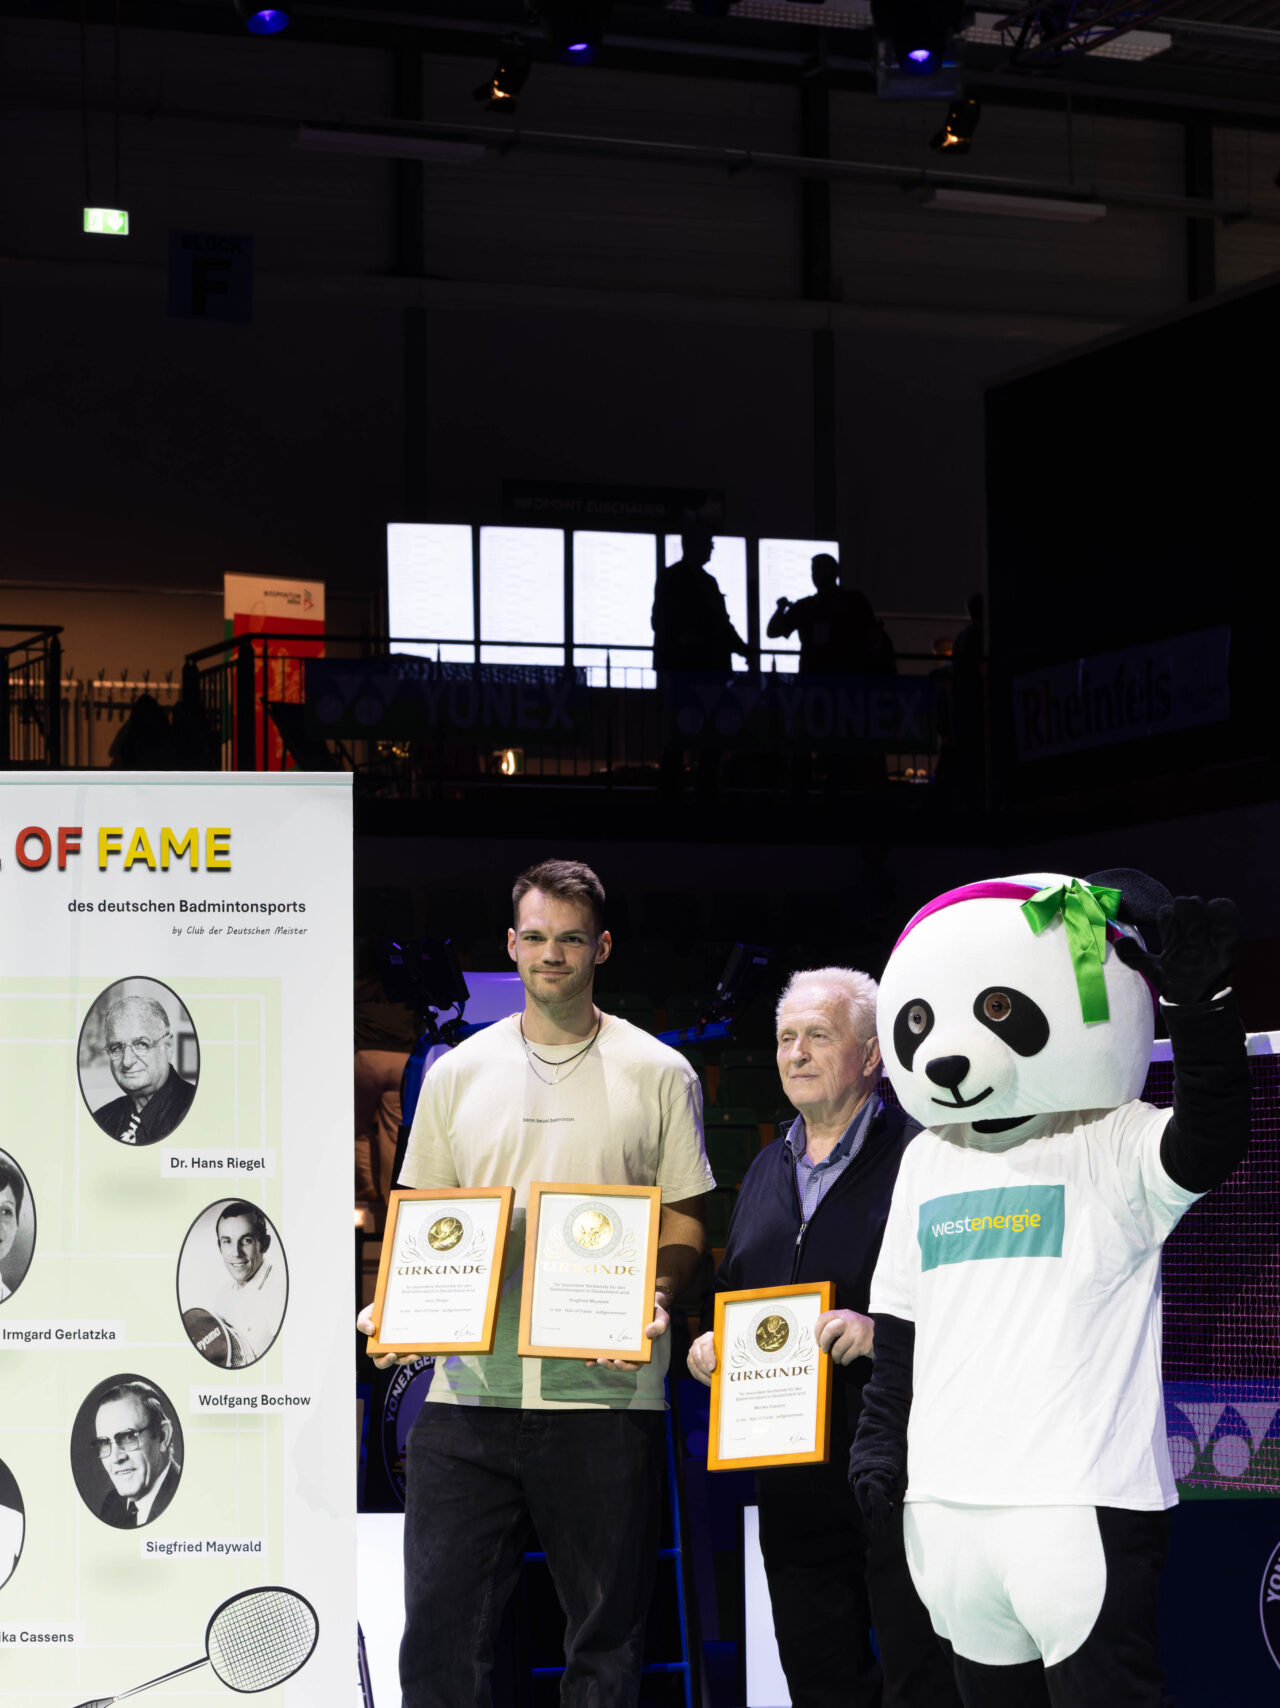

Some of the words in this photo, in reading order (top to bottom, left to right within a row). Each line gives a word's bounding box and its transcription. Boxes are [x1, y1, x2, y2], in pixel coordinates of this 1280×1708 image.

[421, 678, 575, 731] YONEX
[15, 825, 83, 872] OF
[97, 826, 233, 872] FAME
[67, 899, 95, 913] des
[97, 899, 176, 913] deutschen
[179, 899, 307, 916] Badmintonsports
[171, 926, 182, 936] by
[186, 925, 205, 935] Club
[208, 926, 223, 935] der
[226, 926, 271, 936] Deutschen
[274, 926, 308, 935] Meister
[169, 1157, 189, 1169] Dr.
[191, 1157, 224, 1169] Hans
[226, 1156, 266, 1172] Riegel
[931, 1208, 1042, 1238] westenergie
[2, 1328, 51, 1343] Irmgard
[55, 1328, 116, 1340] Gerlatzka
[727, 1364, 816, 1382] URKUNDE
[386, 1363, 414, 1423] YONEX
[198, 1394, 258, 1409] Wolfgang
[261, 1394, 311, 1407] Bochow
[146, 1540, 202, 1556] Siegfried
[206, 1540, 262, 1556] Maywald
[20, 1631, 75, 1644] Cassens
